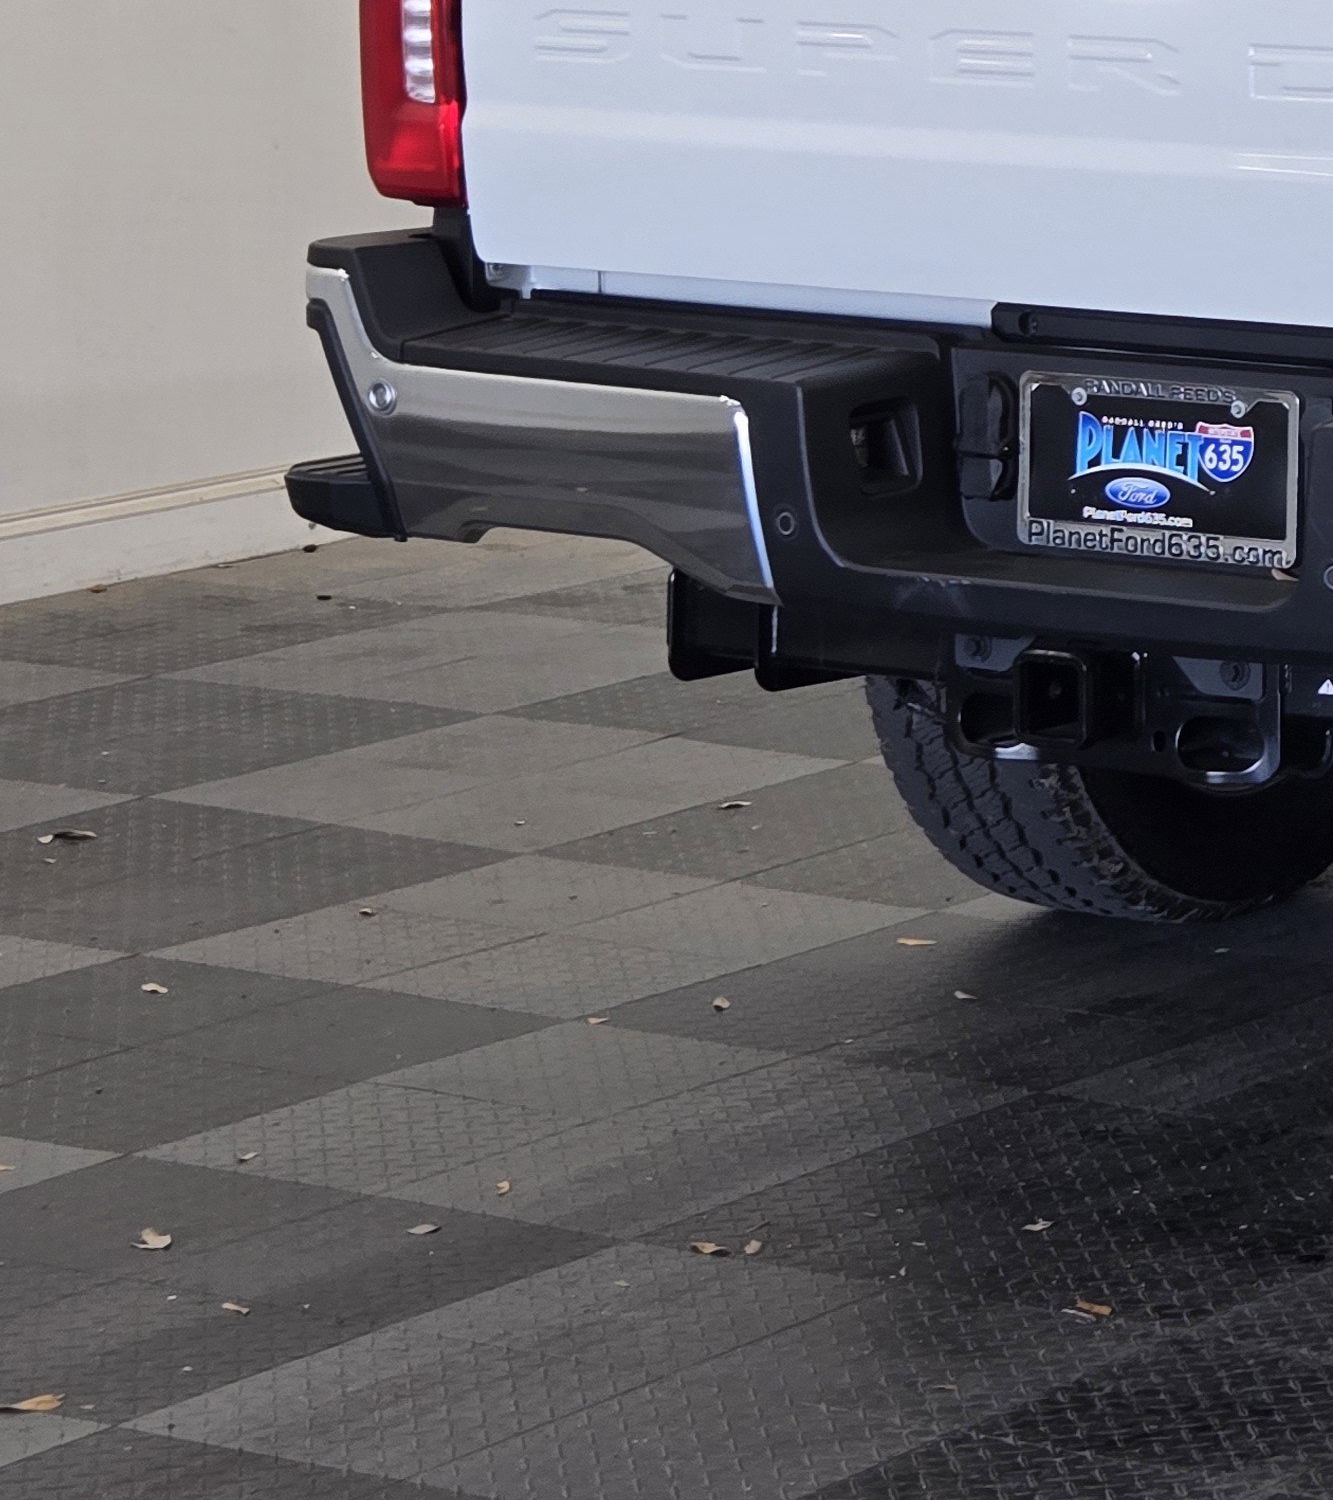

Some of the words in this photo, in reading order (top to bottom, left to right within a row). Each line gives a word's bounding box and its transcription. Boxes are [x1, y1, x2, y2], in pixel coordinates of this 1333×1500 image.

[534, 7, 1182, 97] SUPER
[1084, 377, 1166, 399] RANDALL
[1076, 410, 1204, 482] PLANET
[1204, 443, 1245, 472] 635
[1118, 483, 1160, 504] Ford
[1028, 518, 1293, 569] PlanetFord635.com
